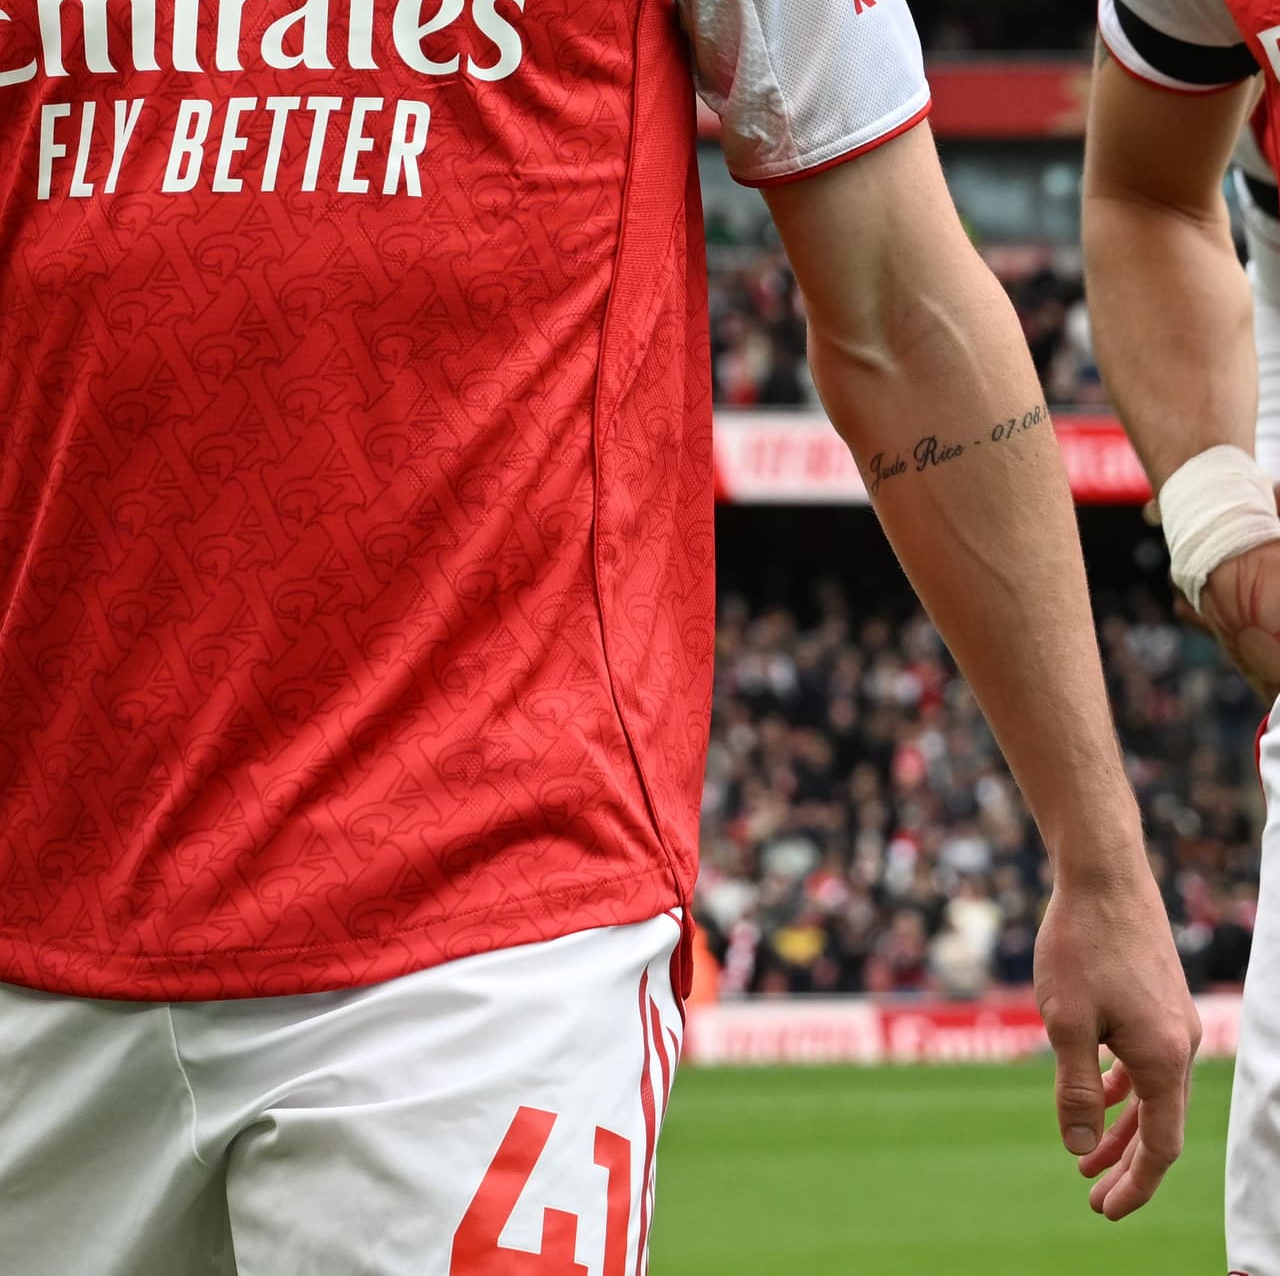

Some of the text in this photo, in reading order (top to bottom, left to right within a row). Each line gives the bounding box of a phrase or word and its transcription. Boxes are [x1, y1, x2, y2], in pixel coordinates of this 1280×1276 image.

[37, 96, 431, 200] FLY BETTER
[870, 452, 907, 495] Jude
[449, 1105, 632, 1276] 41
